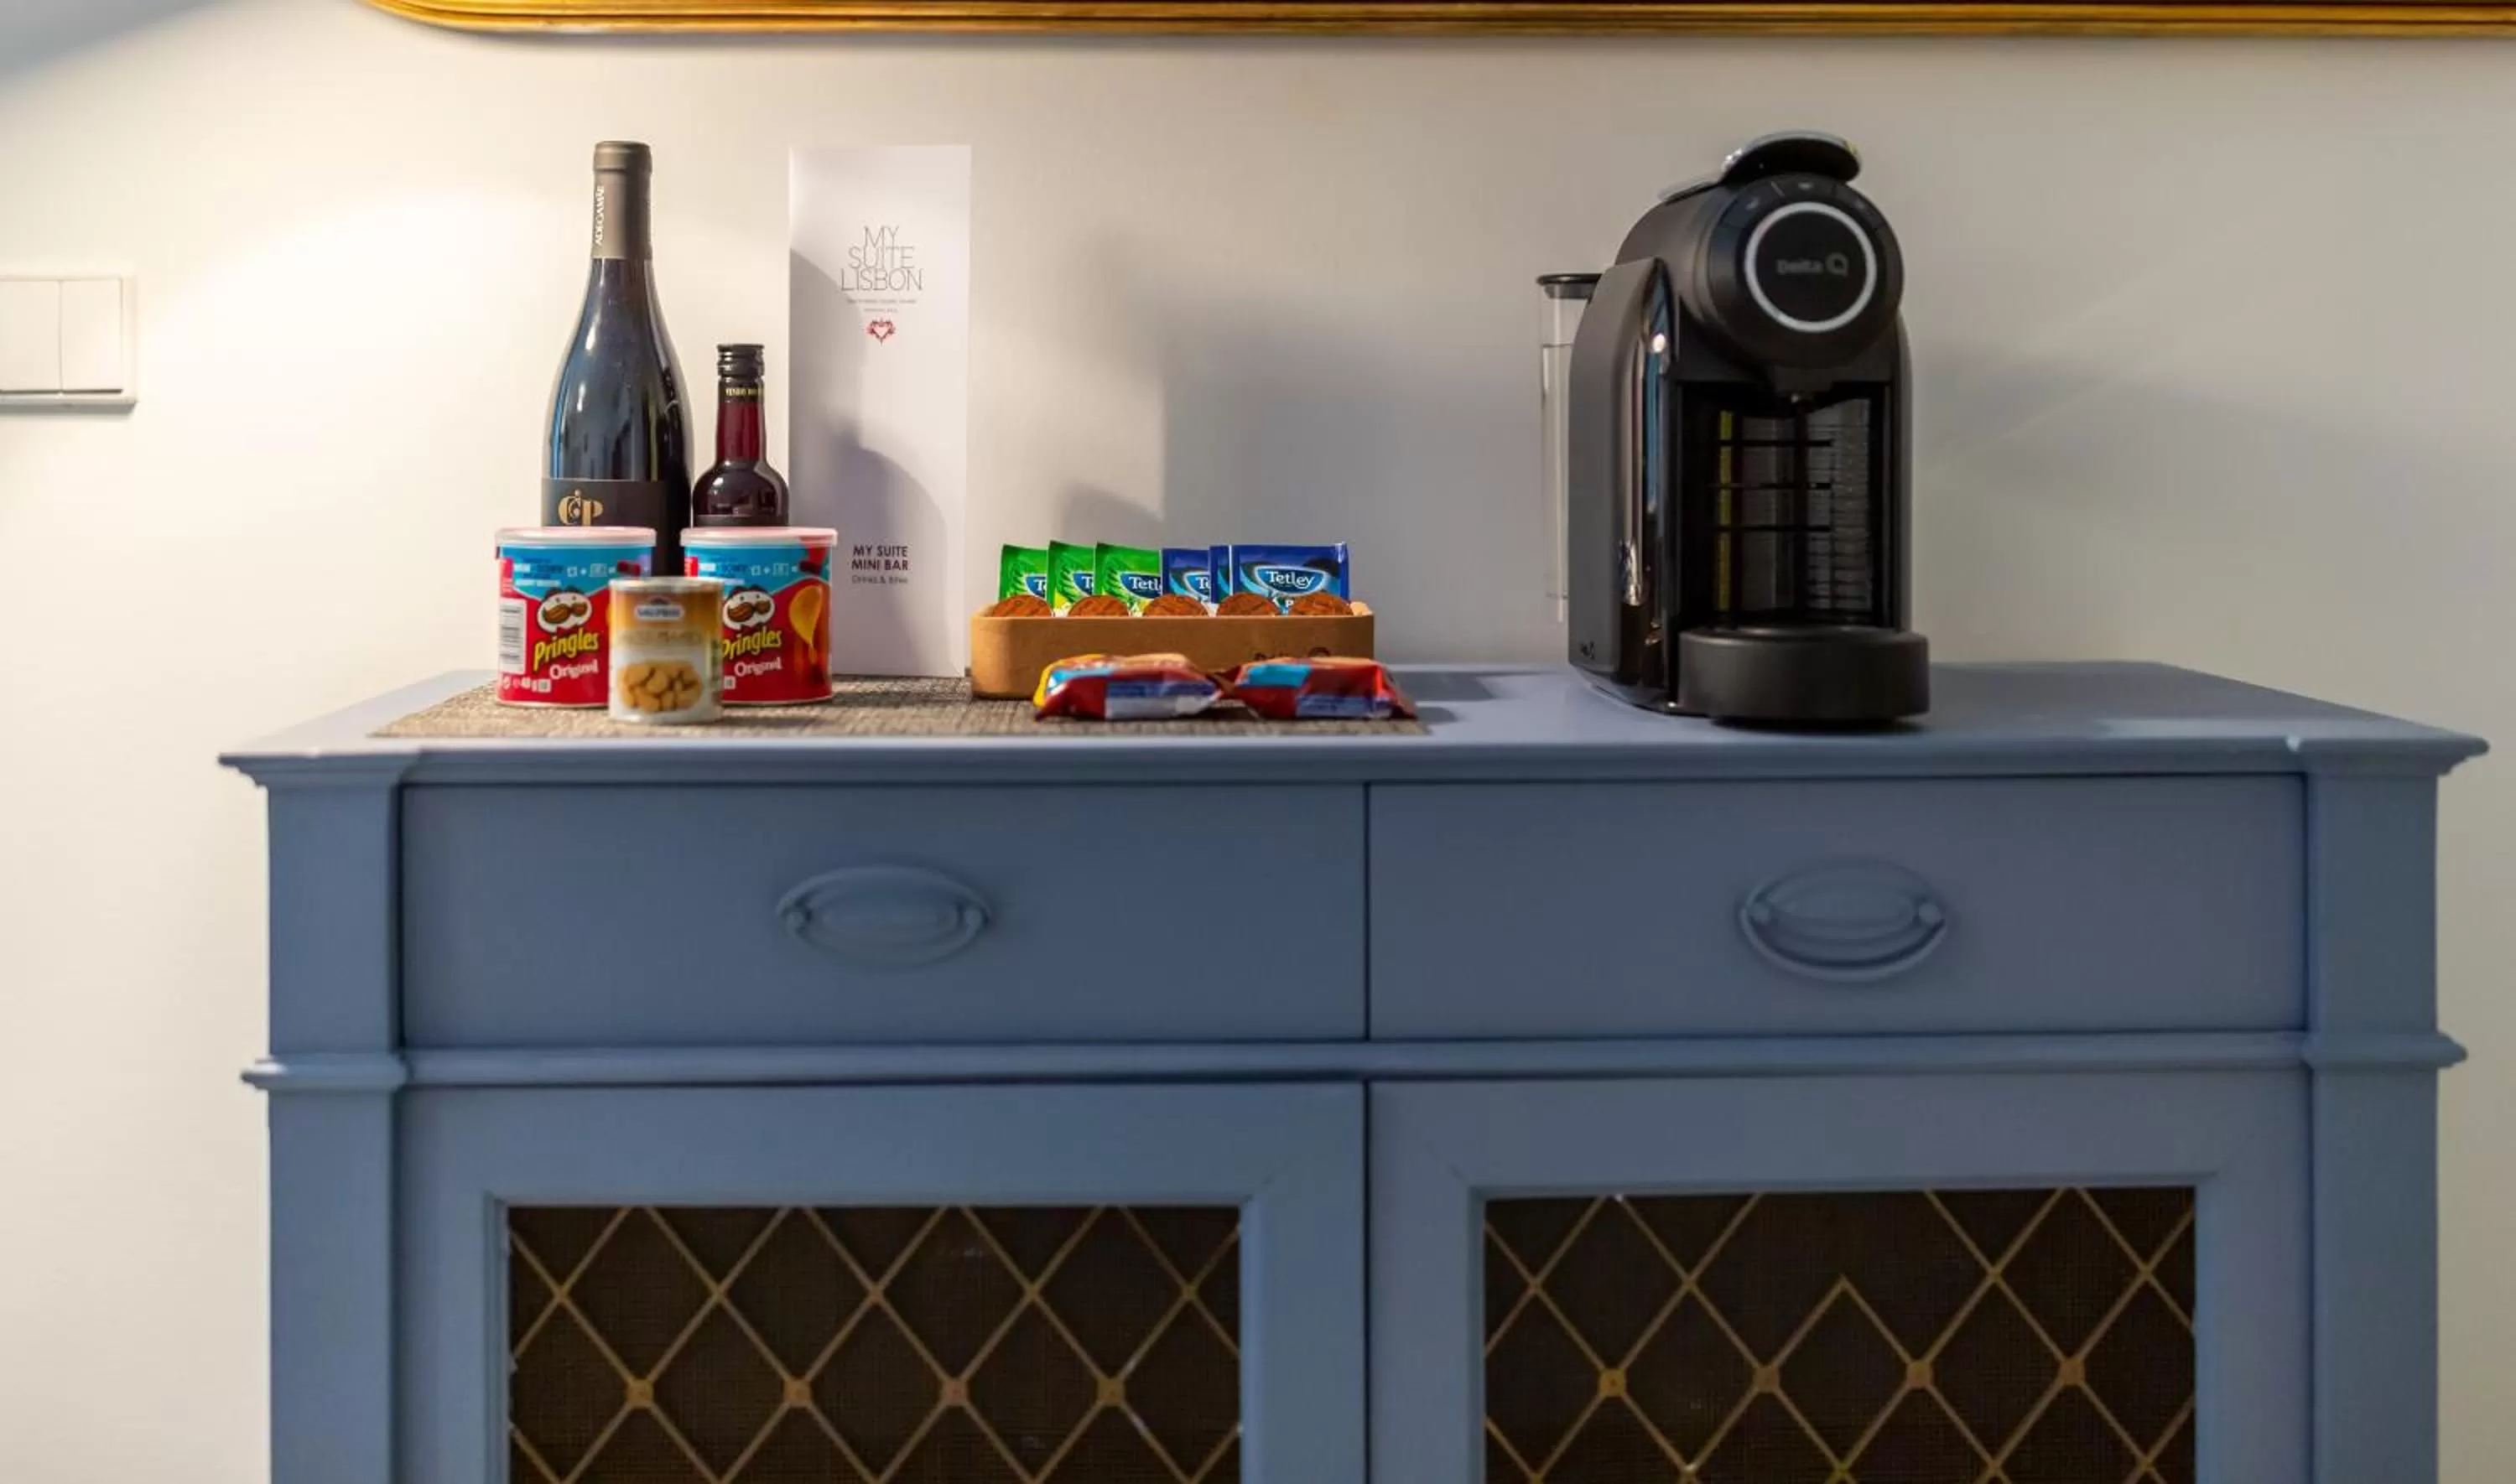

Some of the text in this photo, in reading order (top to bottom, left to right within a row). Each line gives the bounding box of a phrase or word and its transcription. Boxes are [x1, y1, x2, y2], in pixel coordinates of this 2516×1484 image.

[864, 225, 899, 248] MY
[847, 246, 914, 269] SUITE
[840, 267, 923, 291] LISBON
[853, 545, 908, 558] MY SUITE
[851, 559, 908, 571] MINI BAR
[1128, 576, 1162, 594] Tetl
[1266, 570, 1315, 589] Tetley
[533, 627, 600, 672] Pringles
